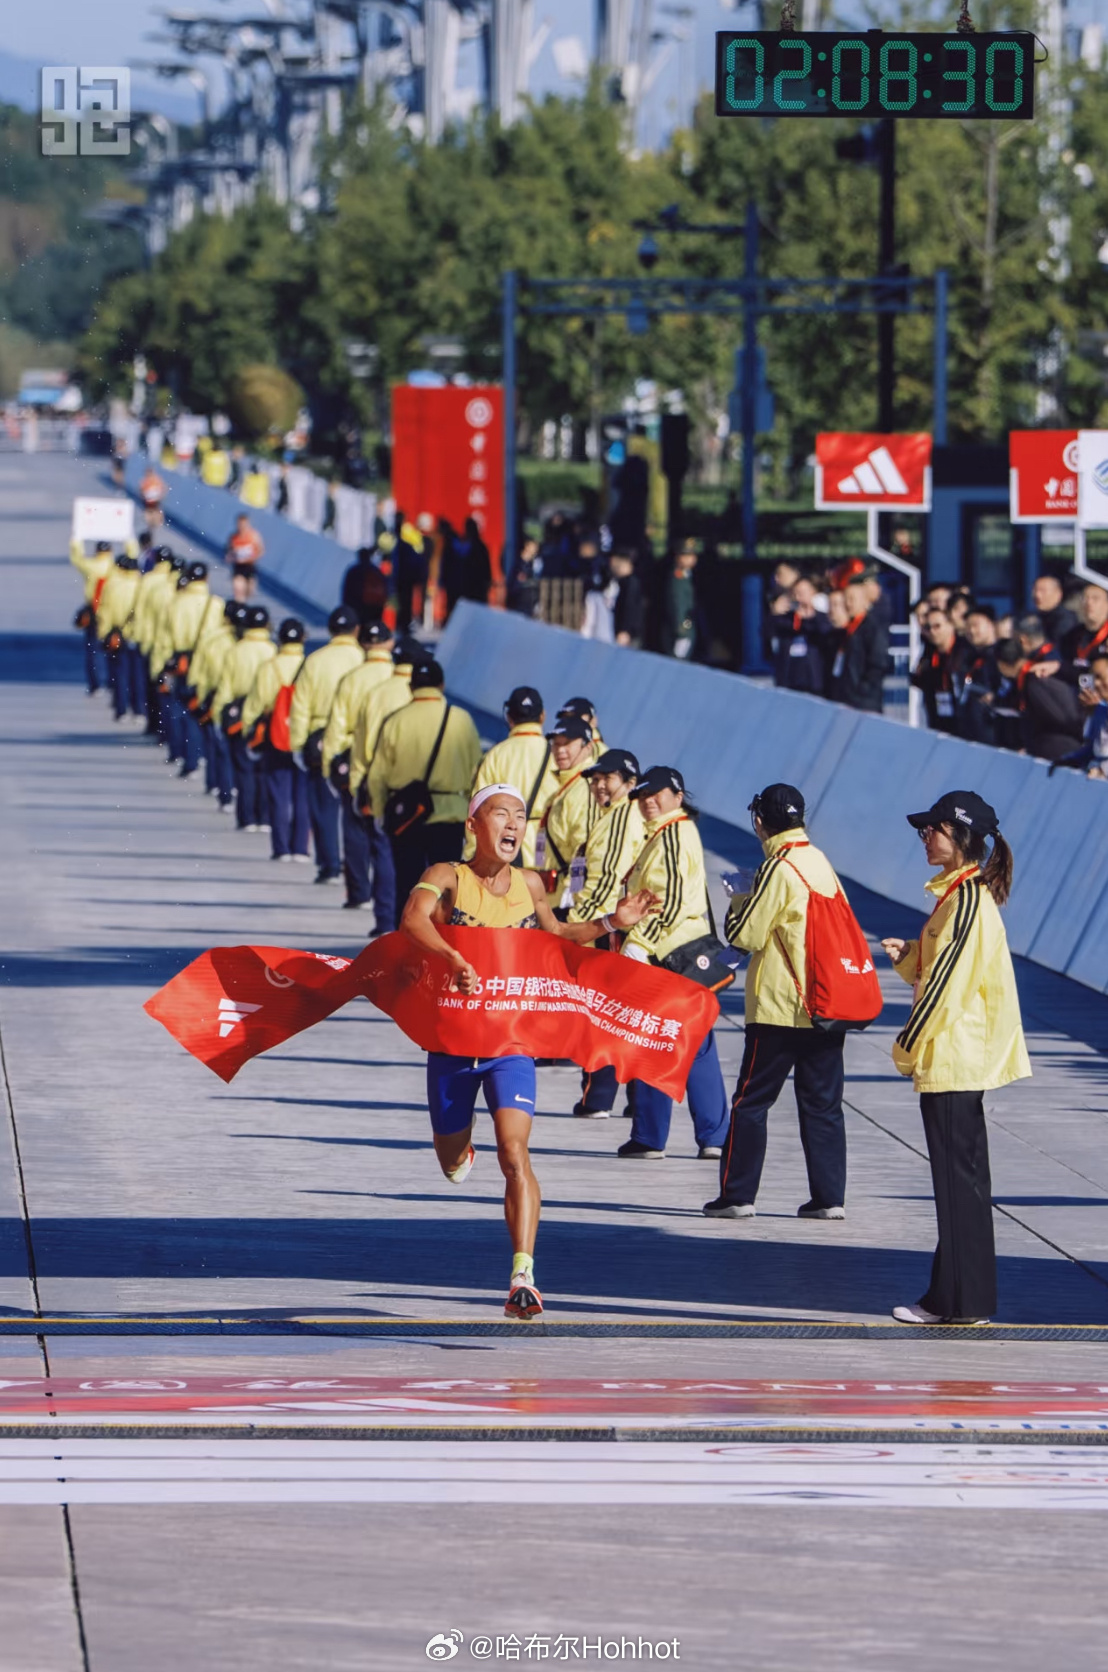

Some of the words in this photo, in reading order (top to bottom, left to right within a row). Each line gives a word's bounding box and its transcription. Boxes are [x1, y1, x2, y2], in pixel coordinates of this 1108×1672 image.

[726, 38, 1024, 111] 02:08:30
[437, 997, 464, 1009] BANK
[466, 1000, 482, 1010] OF
[484, 1000, 518, 1011] CHINA
[600, 1019, 675, 1052] CHAMPIONSHIPS
